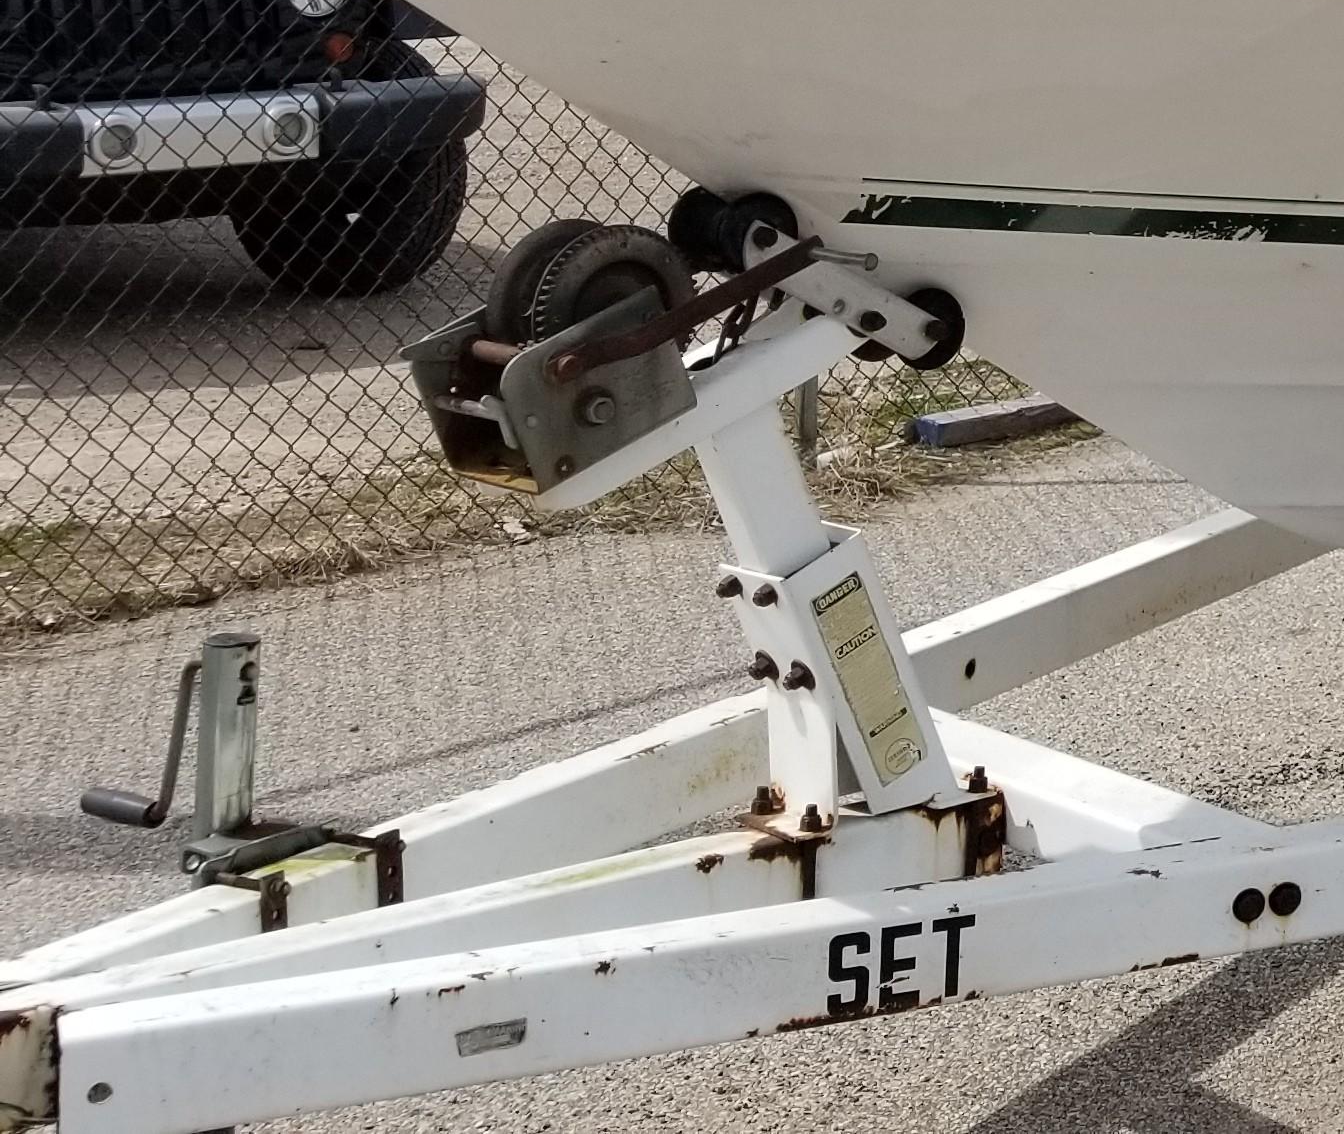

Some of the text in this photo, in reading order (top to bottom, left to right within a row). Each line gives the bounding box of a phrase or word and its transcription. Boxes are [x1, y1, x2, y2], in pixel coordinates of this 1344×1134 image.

[820, 578, 858, 610] DANGER
[836, 626, 877, 659] CAUTION
[827, 914, 976, 1016] SET
